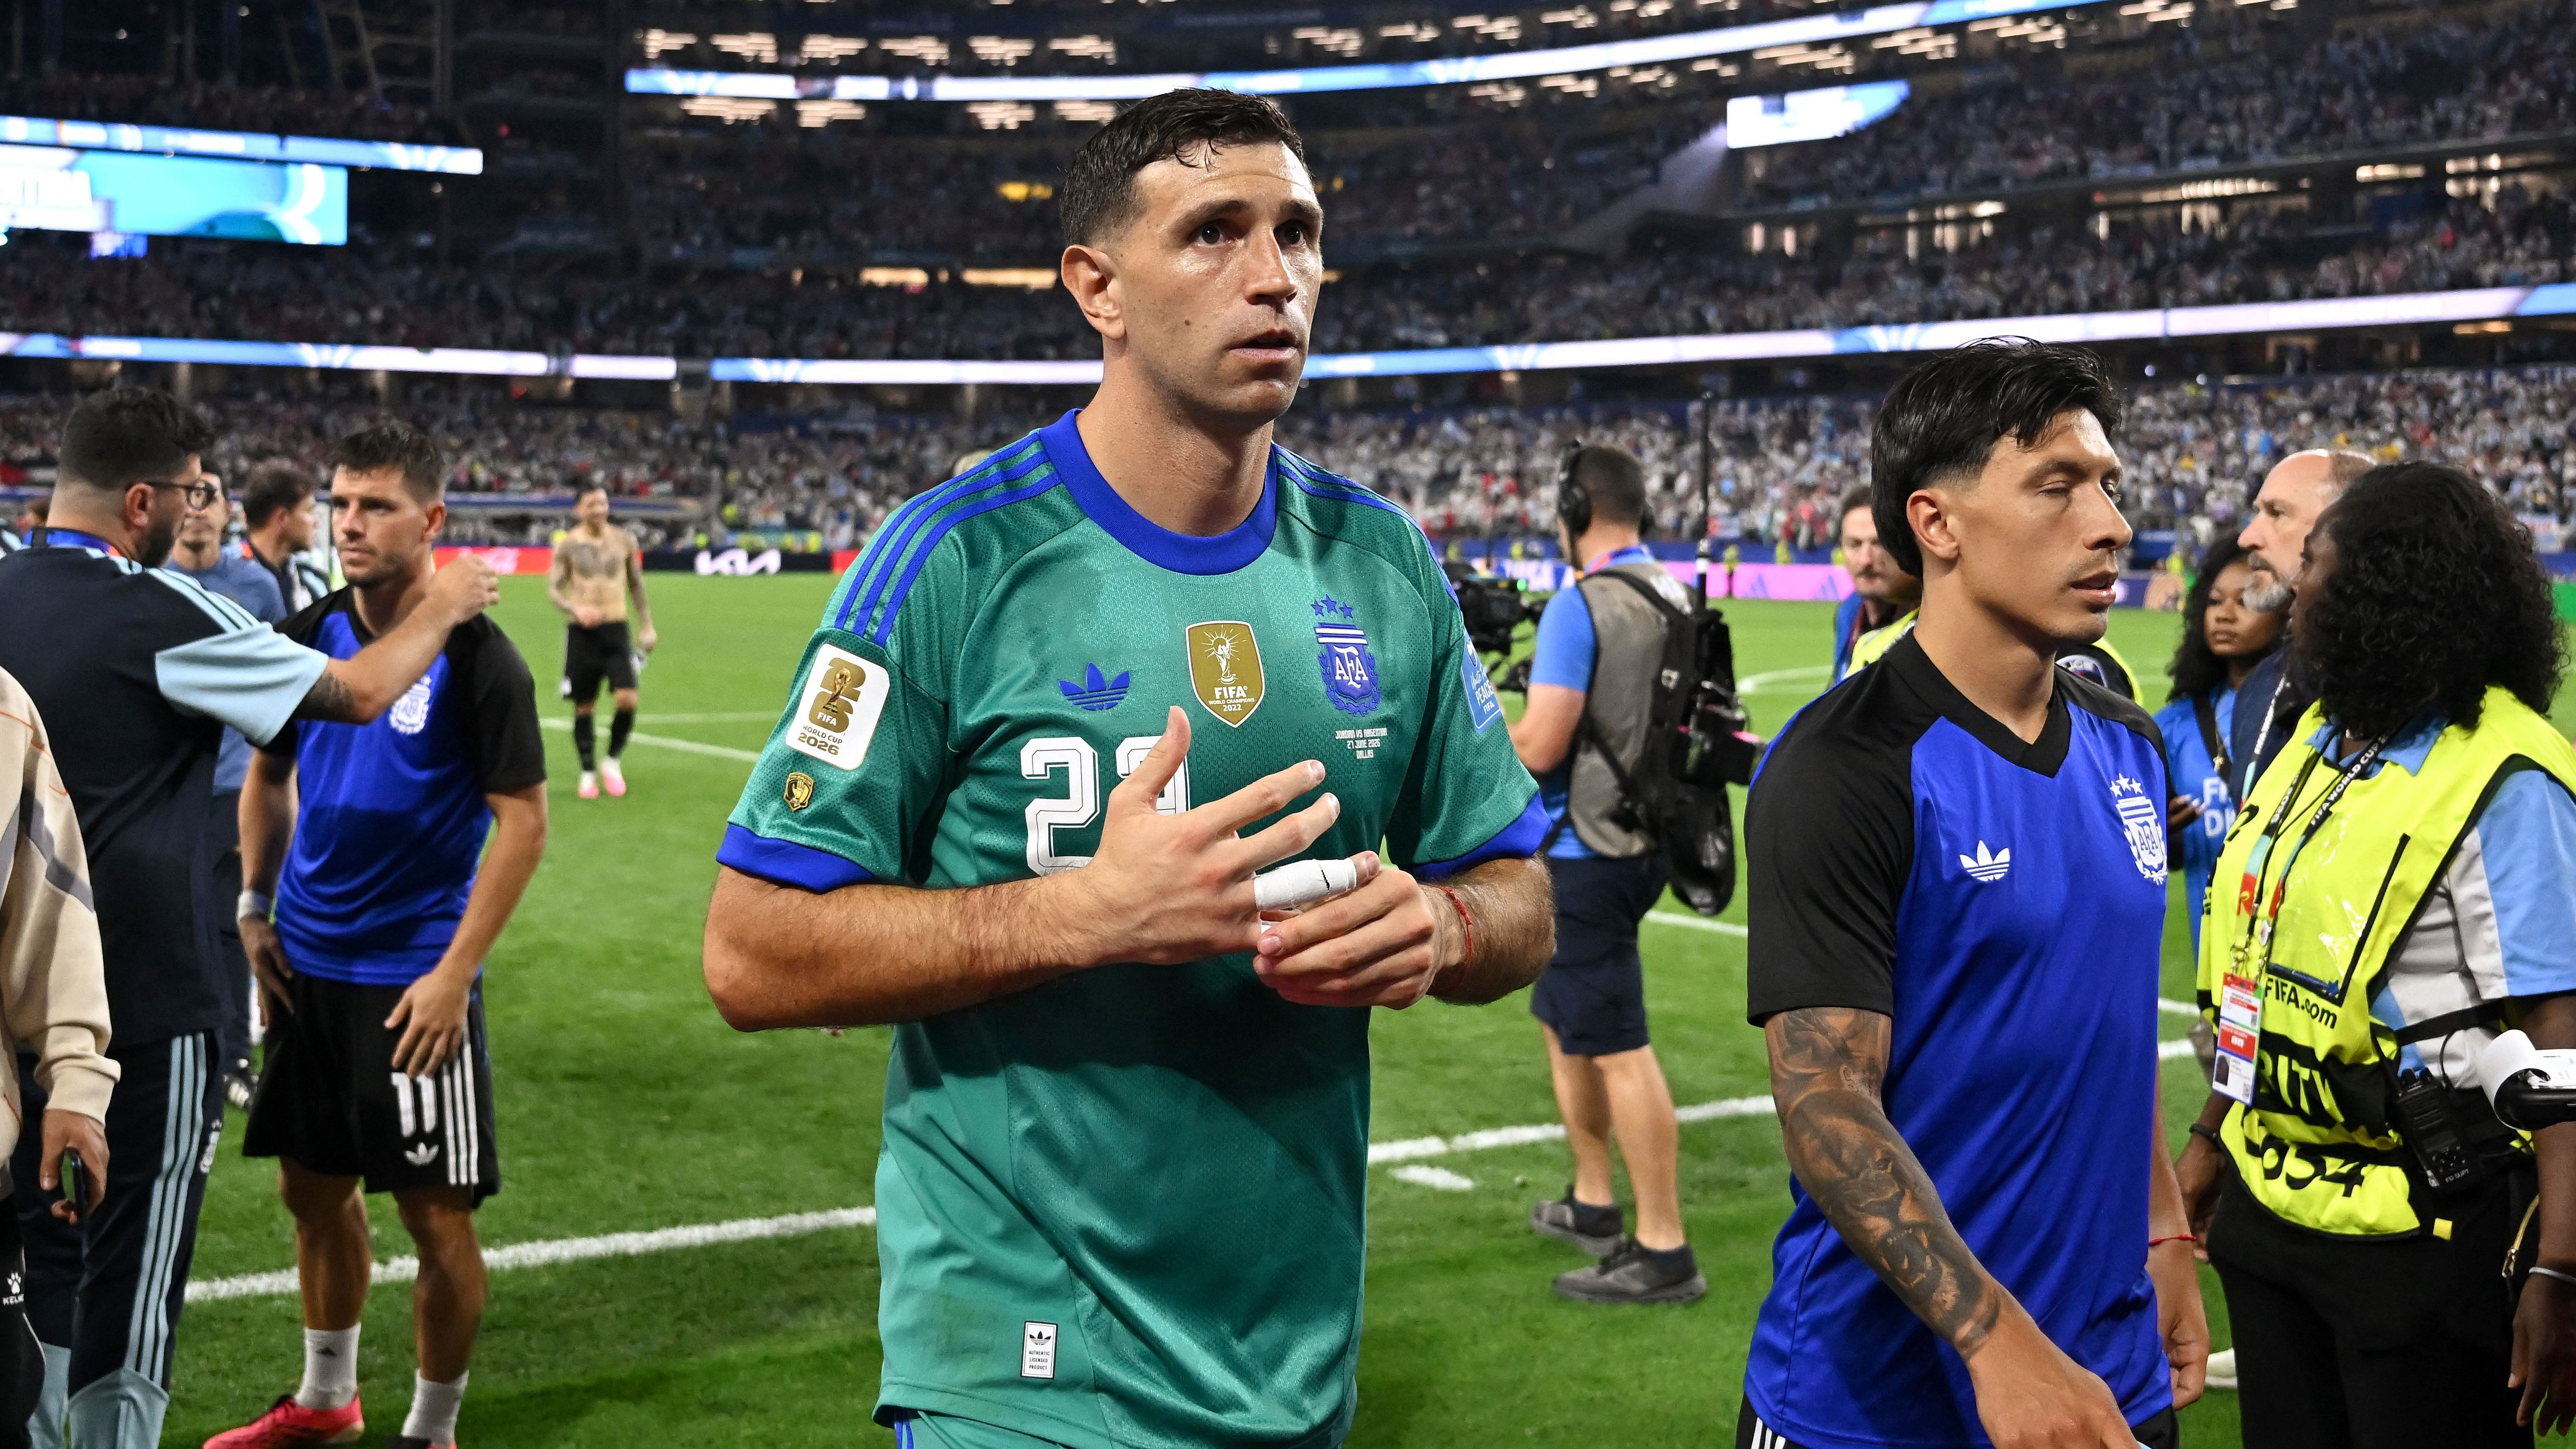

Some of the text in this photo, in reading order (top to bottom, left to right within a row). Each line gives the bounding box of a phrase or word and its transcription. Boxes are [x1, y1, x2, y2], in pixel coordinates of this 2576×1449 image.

[1475, 679, 1494, 707] PEACE
[1483, 700, 1495, 714] FIFA
[817, 712, 837, 726] FIFA
[803, 725, 843, 744] WORLD CUP
[1335, 727, 1388, 740] JORDAN VS ARGENTINA
[798, 732, 840, 755] 2026
[1347, 739, 1381, 749] 27 JUNE 2026
[1356, 750, 1374, 759] DALLAS
[2310, 743, 2380, 826] FIFA WORLD CUP
[2264, 978, 2337, 1029] FIFA.com
[391, 1072, 438, 1138] 11
